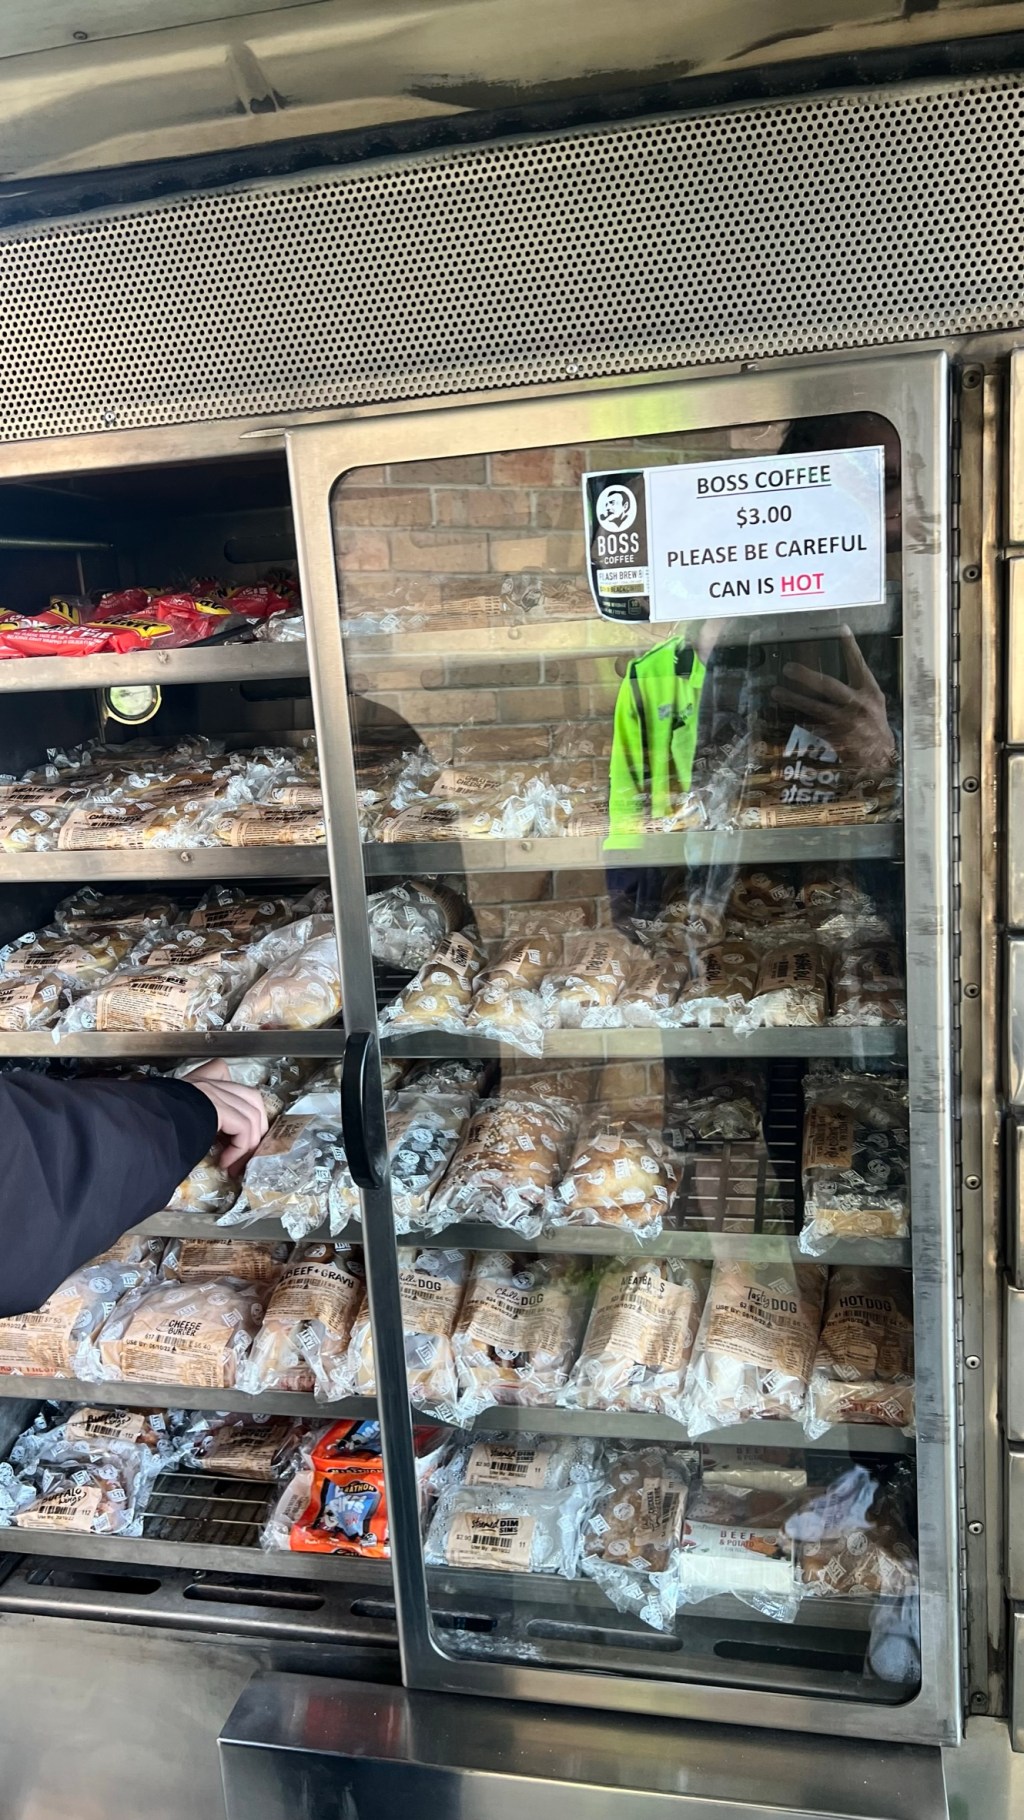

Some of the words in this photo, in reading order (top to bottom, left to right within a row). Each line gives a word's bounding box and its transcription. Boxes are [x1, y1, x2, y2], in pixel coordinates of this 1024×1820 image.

[697, 473, 748, 495] BOSS
[755, 465, 831, 488] COFFEE
[736, 505, 792, 529] $3.00
[597, 532, 639, 556] BOSS
[667, 545, 737, 568] PLEASE
[744, 543, 767, 560] BE
[775, 534, 867, 558] CAREFUL
[604, 554, 635, 565] COFFEE
[619, 570, 637, 580] BREW
[709, 578, 750, 598] CAN
[758, 577, 774, 594] IS
[781, 573, 825, 592] HOT
[418, 1279, 441, 1291] DOG
[521, 1293, 544, 1306] DOG
[744, 1285, 772, 1309] Tasty
[771, 1298, 797, 1313] DOG
[840, 1295, 864, 1308] HOT
[866, 1299, 892, 1312] DOG
[716, 1303, 729, 1311] USE
[168, 1319, 203, 1331] CHEESE
[168, 1327, 197, 1337] BURGER
[87, 1412, 127, 1424] BUFFALO
[720, 1531, 756, 1541] BEEF
[727, 1539, 755, 1548] POTATO
